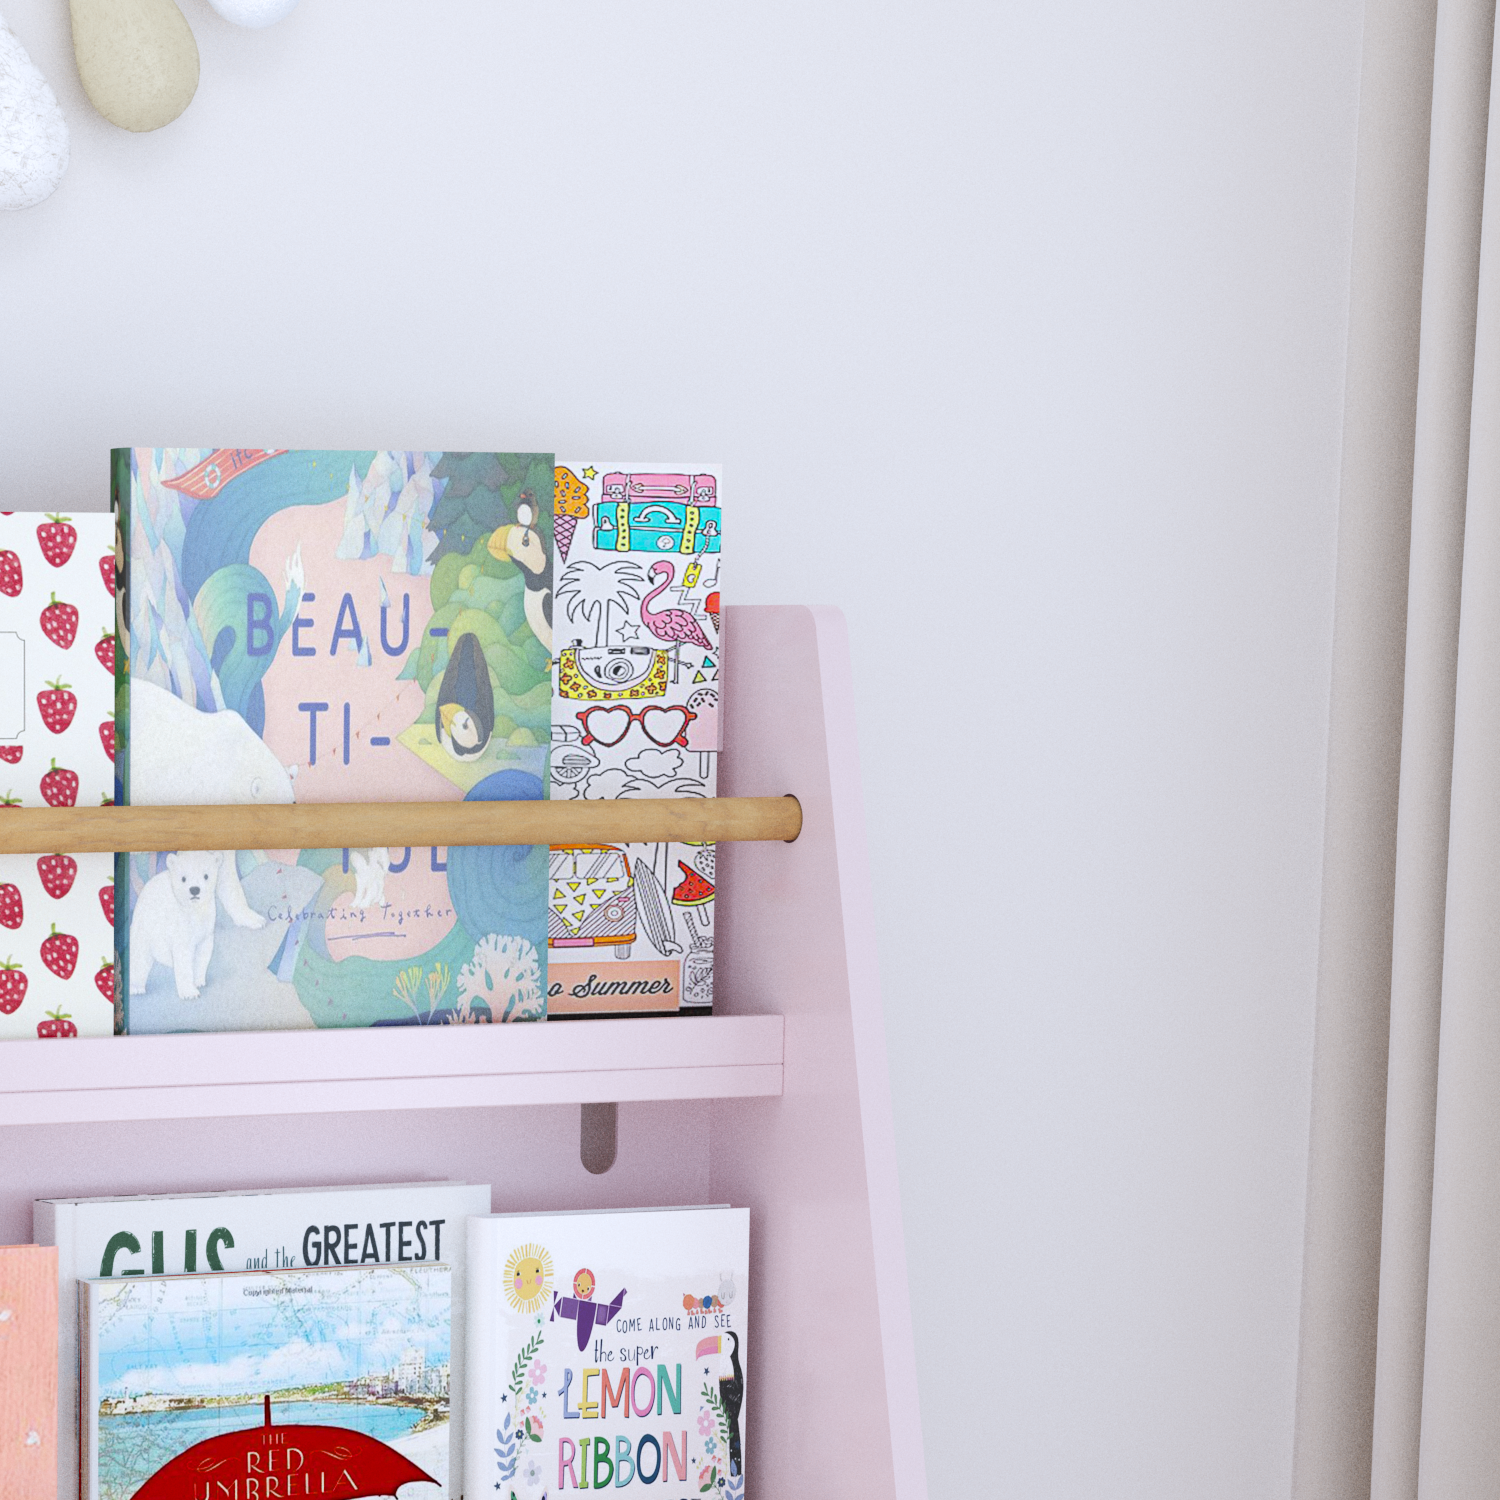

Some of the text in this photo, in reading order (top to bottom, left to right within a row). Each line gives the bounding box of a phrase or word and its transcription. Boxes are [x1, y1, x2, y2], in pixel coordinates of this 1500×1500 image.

[267, 902, 452, 925] Celebrating Together
[568, 974, 674, 999] Summer
[245, 1248, 269, 1270] and
[274, 1246, 297, 1269] the
[302, 1219, 446, 1267] GREATEST
[616, 1314, 732, 1334] COME ALONG AND SEE
[594, 1339, 659, 1366] the super
[557, 1363, 682, 1419] LEMON
[262, 1432, 288, 1446] THE
[248, 1447, 304, 1474] RED
[558, 1430, 688, 1490] RIBBON
